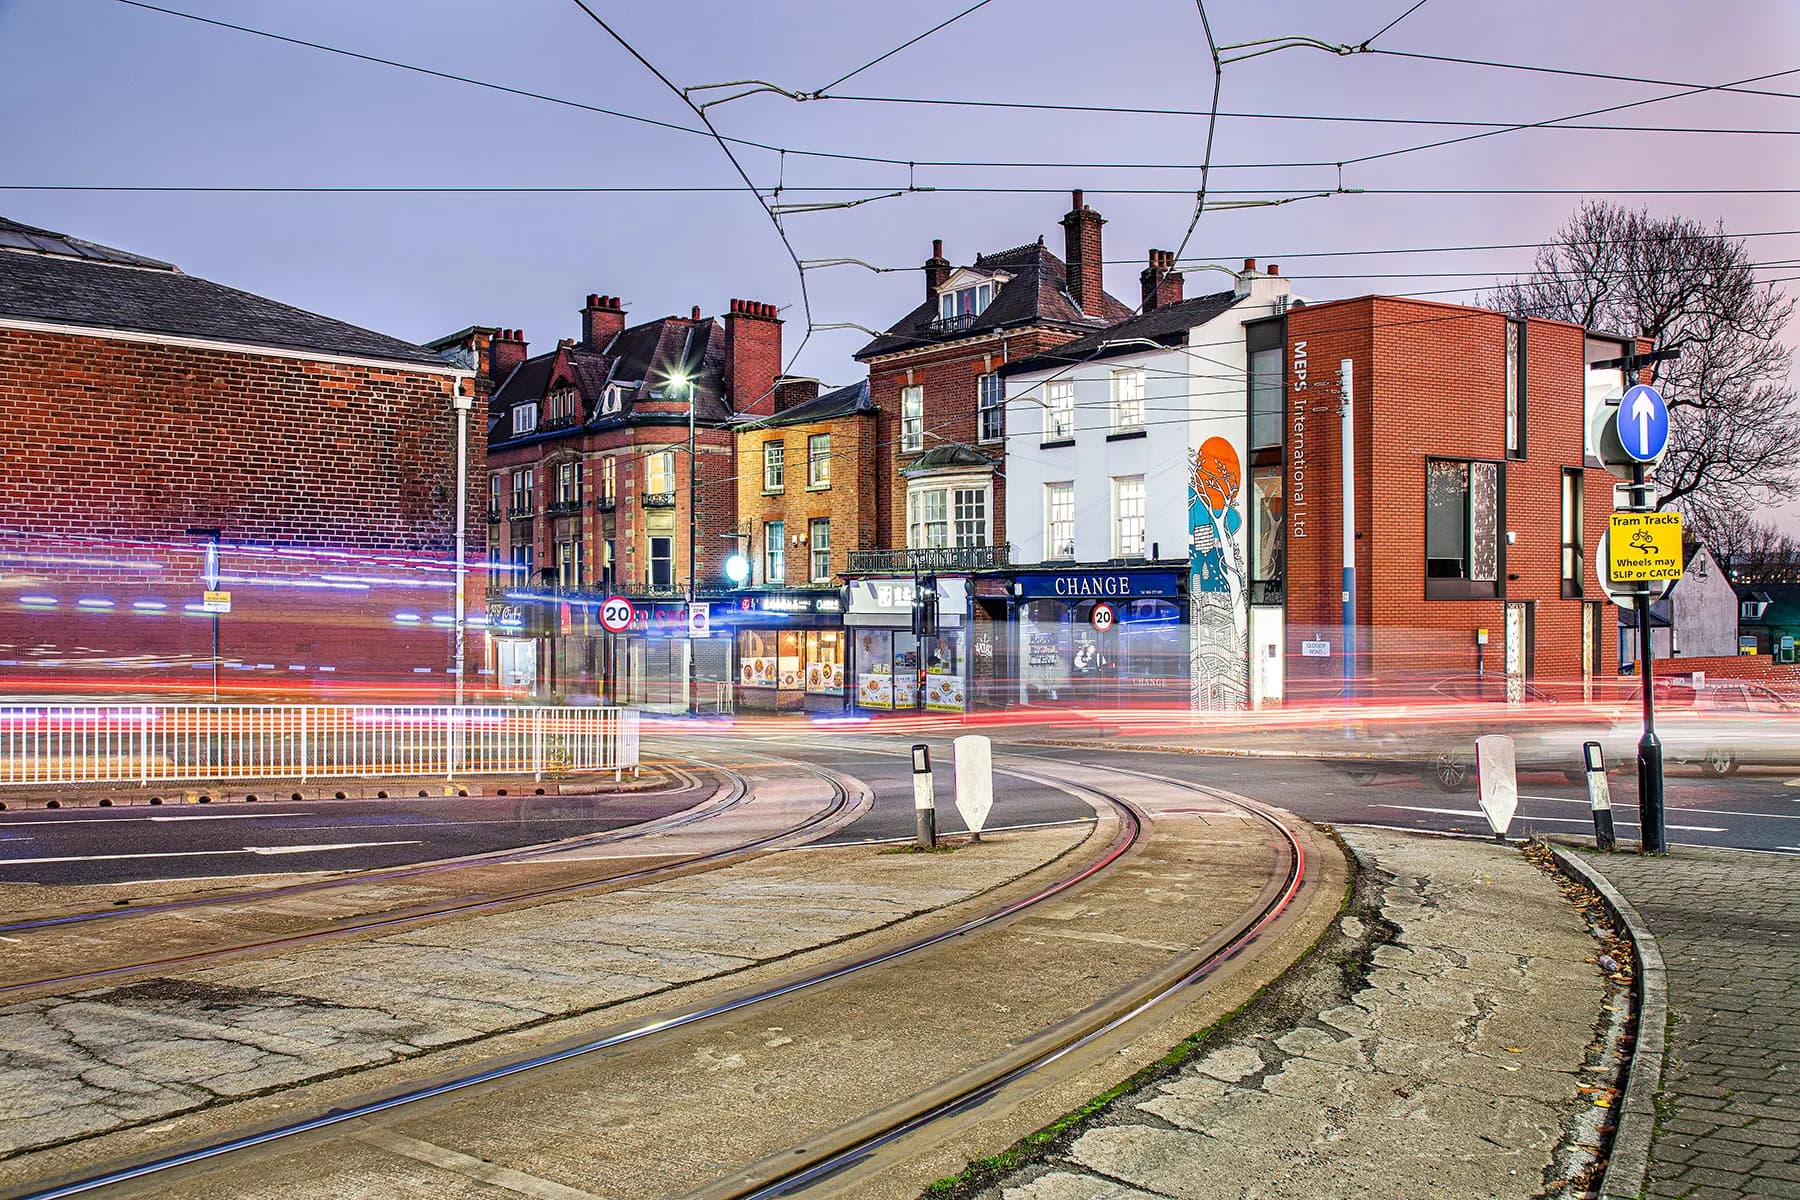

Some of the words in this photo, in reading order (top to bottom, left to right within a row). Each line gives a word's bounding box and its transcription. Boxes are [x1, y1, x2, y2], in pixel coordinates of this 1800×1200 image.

[1293, 341, 1307, 392] MEPS
[1293, 400, 1307, 505] International
[1293, 512, 1307, 538] Ltd
[1612, 516, 1640, 526] Tram
[1644, 515, 1679, 525] Tracks
[1616, 558, 1652, 567] Wheels
[1655, 559, 1676, 567] may
[1613, 570, 1633, 579] SLIP
[1649, 569, 1681, 578] CATCH
[1055, 576, 1130, 596] CHANGE
[606, 606, 629, 622] 20
[1095, 611, 1111, 623] 20
[1132, 677, 1168, 687] CHANGE
